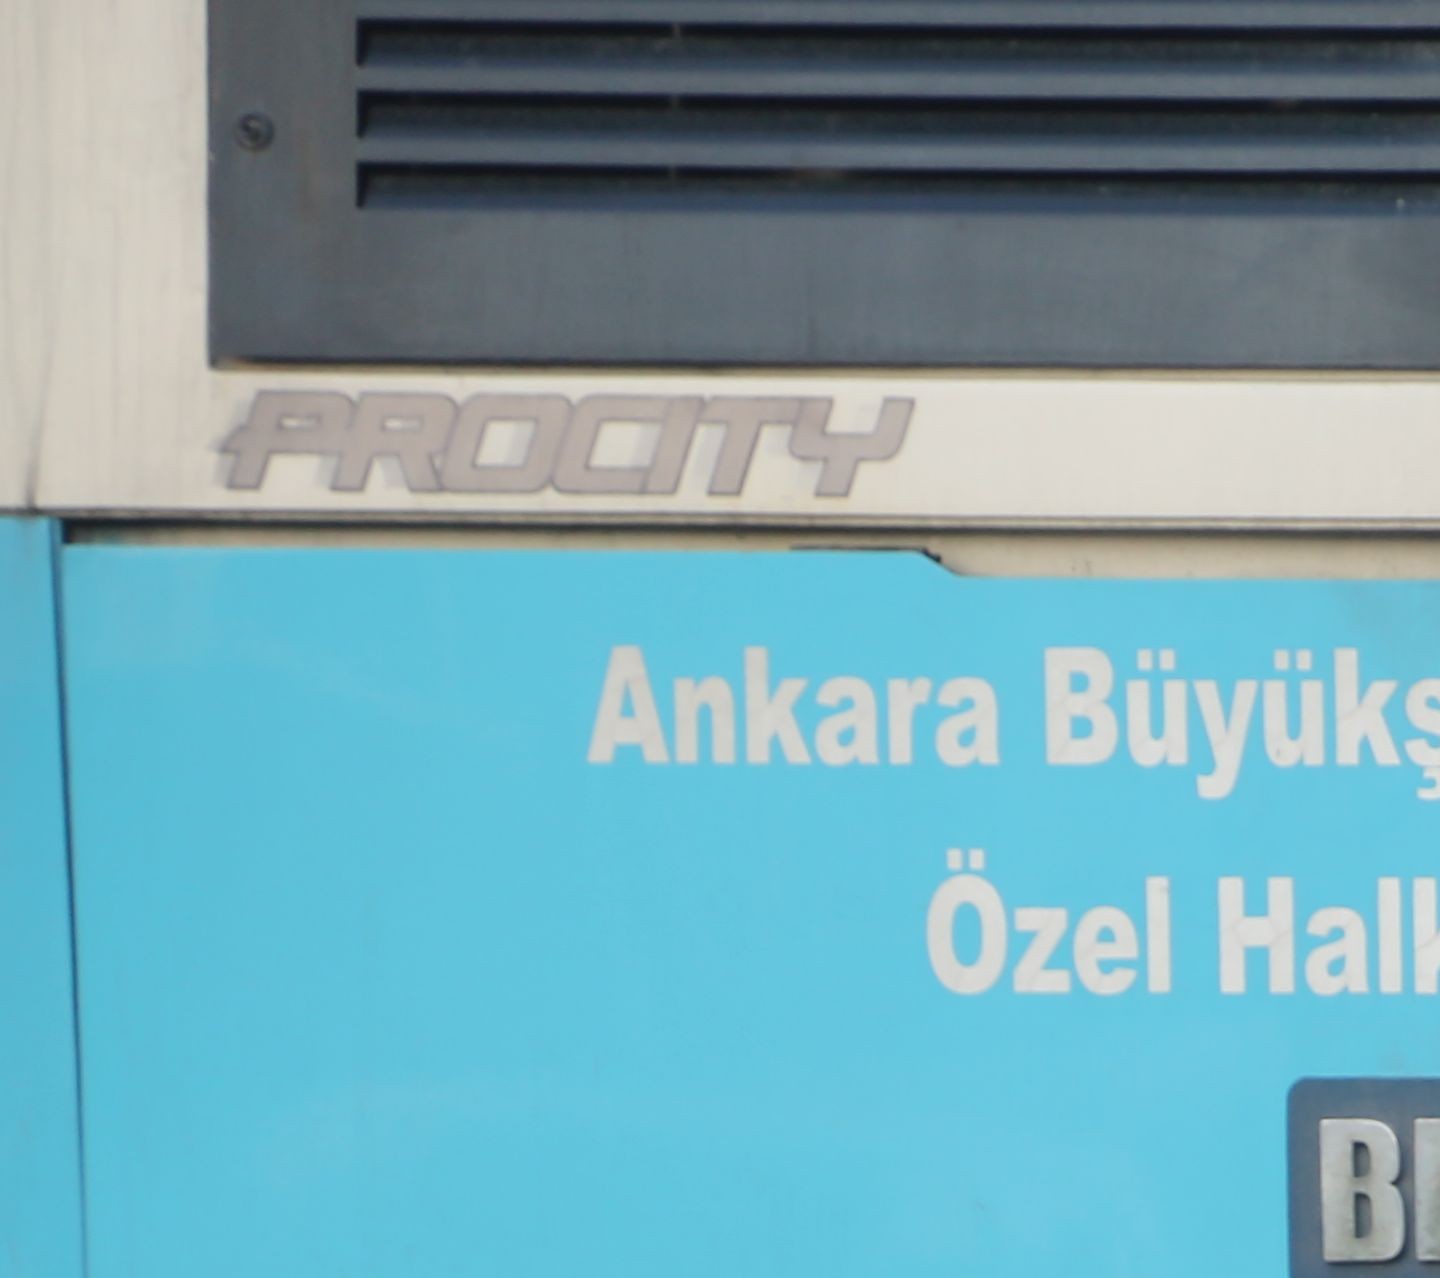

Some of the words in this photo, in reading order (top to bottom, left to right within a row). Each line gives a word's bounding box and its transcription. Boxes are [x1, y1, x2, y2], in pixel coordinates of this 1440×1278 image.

[217, 388, 917, 499] PROCITY
[587, 645, 1001, 767] Ankara
[926, 848, 1172, 997] Özel
